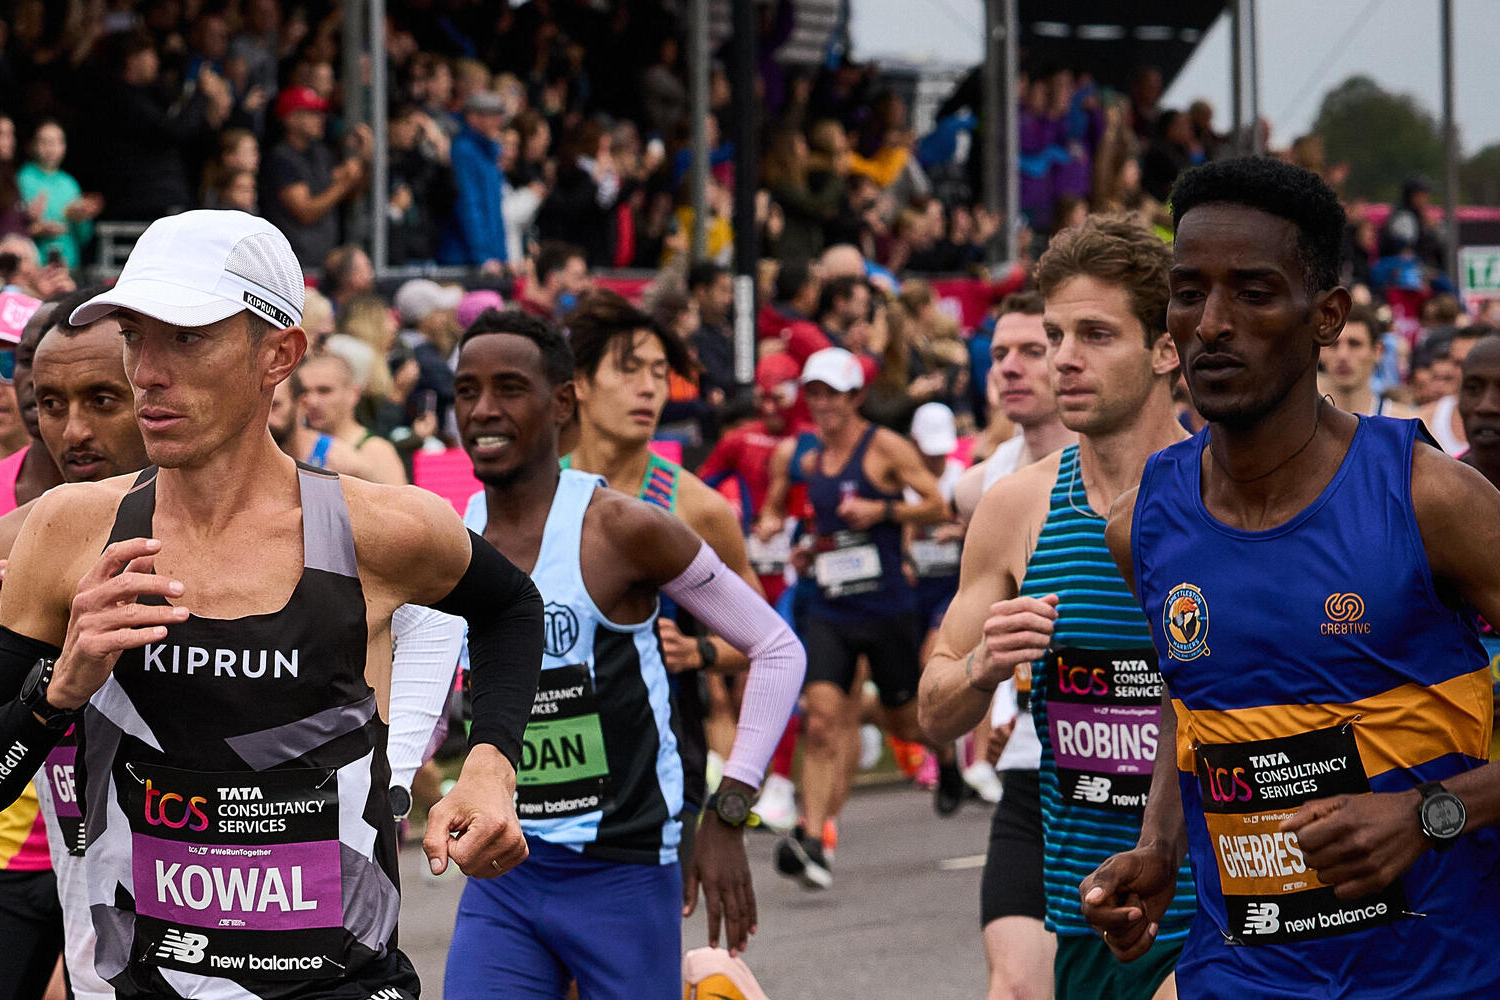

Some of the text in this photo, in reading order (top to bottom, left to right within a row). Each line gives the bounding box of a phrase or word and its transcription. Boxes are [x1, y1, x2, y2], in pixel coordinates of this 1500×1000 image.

[247, 295, 294, 327] KIPRUN TEA
[144, 644, 298, 678] KIPRUN
[1112, 660, 1149, 671] TATA
[1057, 656, 1108, 696] tcs
[1249, 752, 1290, 768] TATA
[1204, 757, 1252, 802] tcs
[1255, 757, 1347, 784] CONSULTANCY
[217, 787, 263, 800] TATA
[1260, 779, 1318, 799] SERVICES
[145, 779, 209, 831] tcs
[217, 800, 325, 817] CONSULTANCY
[544, 795, 599, 813] balance
[1112, 795, 1139, 806] new
[218, 819, 286, 833] SERVICES
[210, 848, 271, 857] #WeRunTogether
[1219, 832, 1308, 878] GHEBRES
[155, 859, 318, 912] KOWAL
[1285, 902, 1388, 933] new balance
[210, 954, 323, 970] new balance
